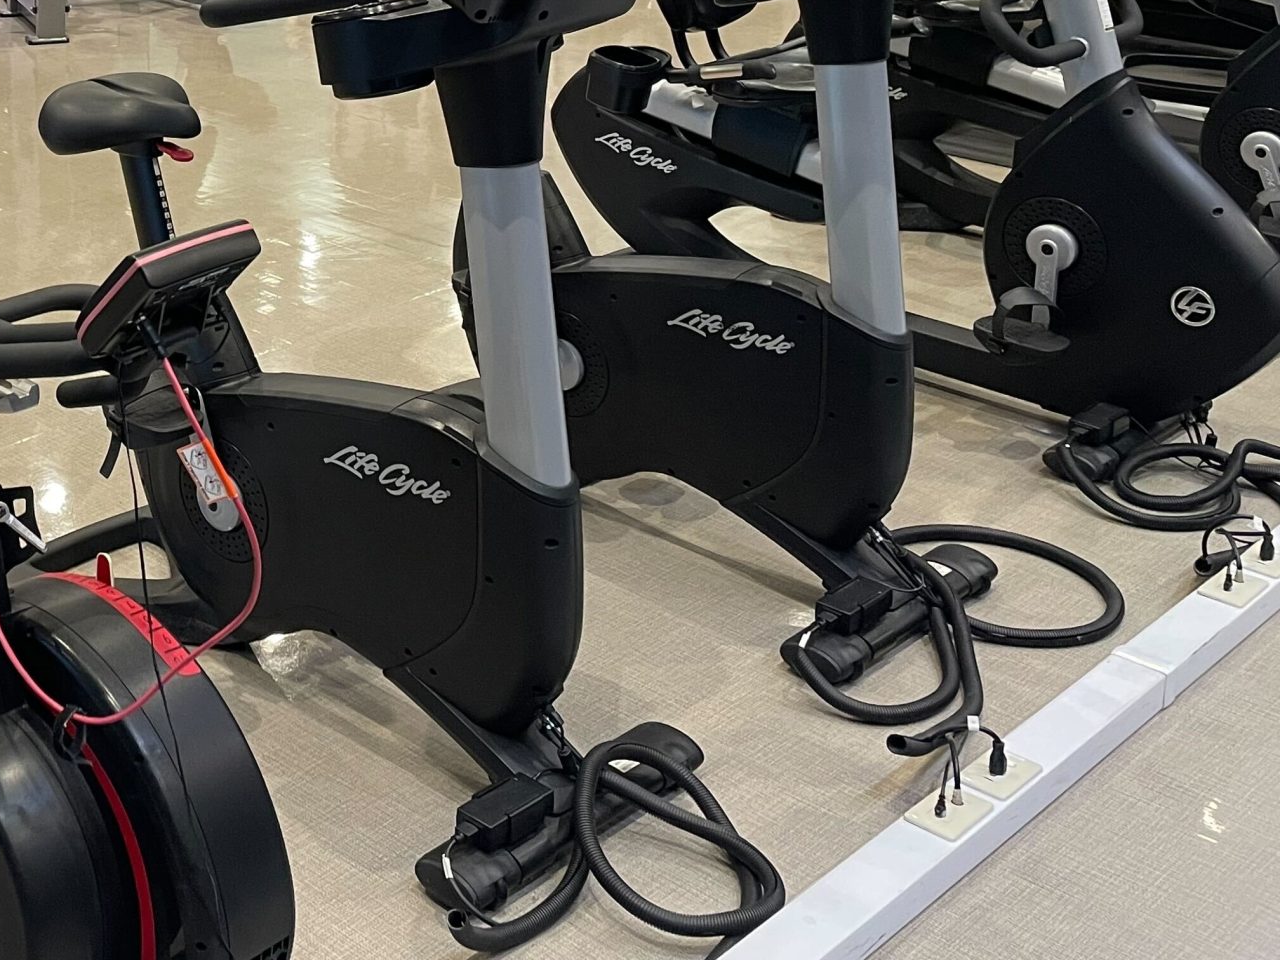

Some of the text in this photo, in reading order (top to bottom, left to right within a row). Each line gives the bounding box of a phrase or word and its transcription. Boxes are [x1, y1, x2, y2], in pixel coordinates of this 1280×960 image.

[595, 132, 678, 174] Life Cycle
[667, 308, 794, 355] Life Cycle
[323, 445, 450, 505] Life Cycle
